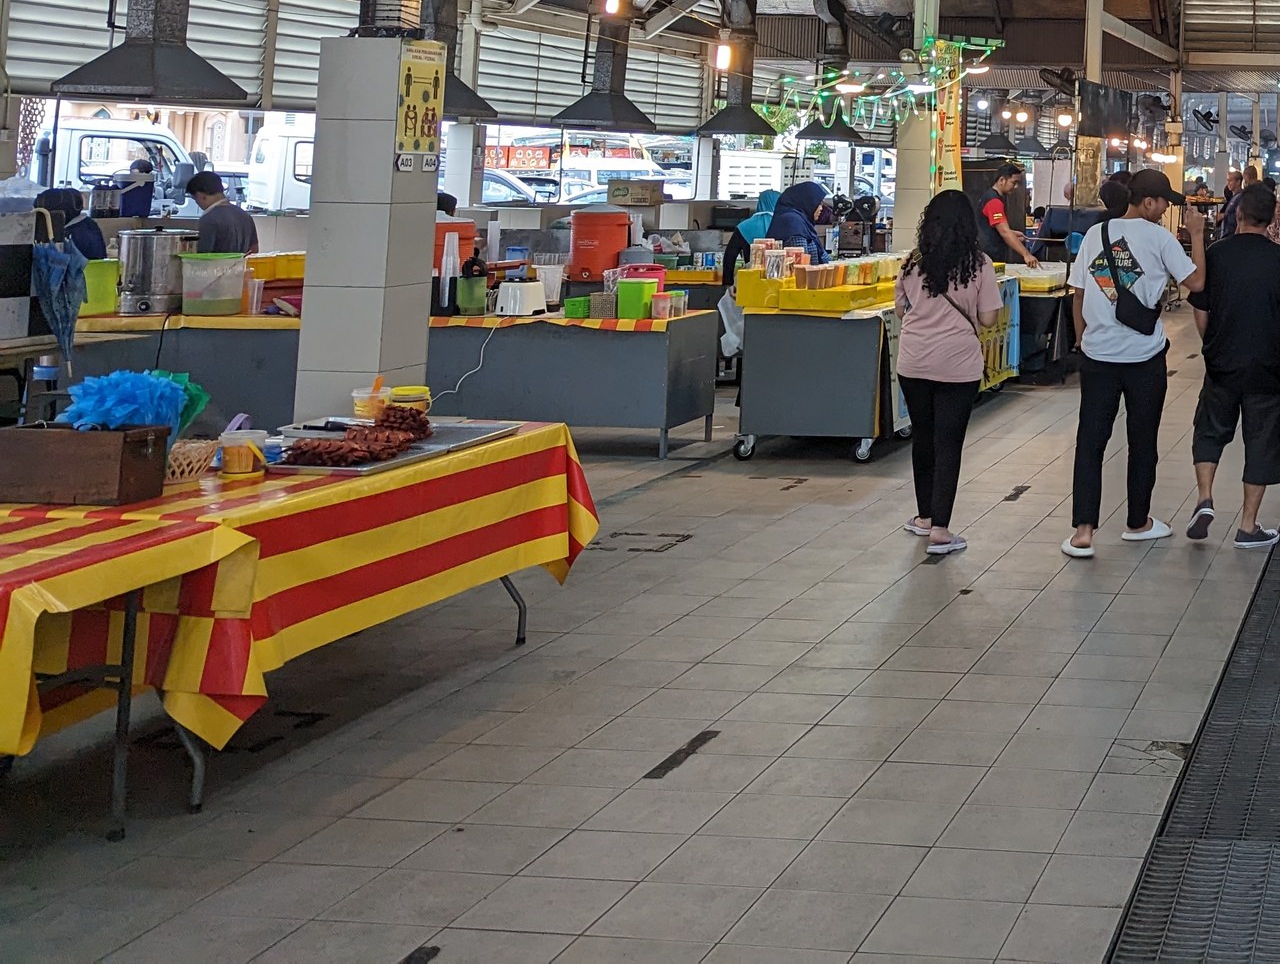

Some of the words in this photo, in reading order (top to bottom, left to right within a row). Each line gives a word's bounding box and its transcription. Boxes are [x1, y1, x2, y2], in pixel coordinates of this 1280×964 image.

[400, 157, 413, 168] A03
[424, 157, 436, 168] A04
[1103, 258, 1133, 267] NTURE
